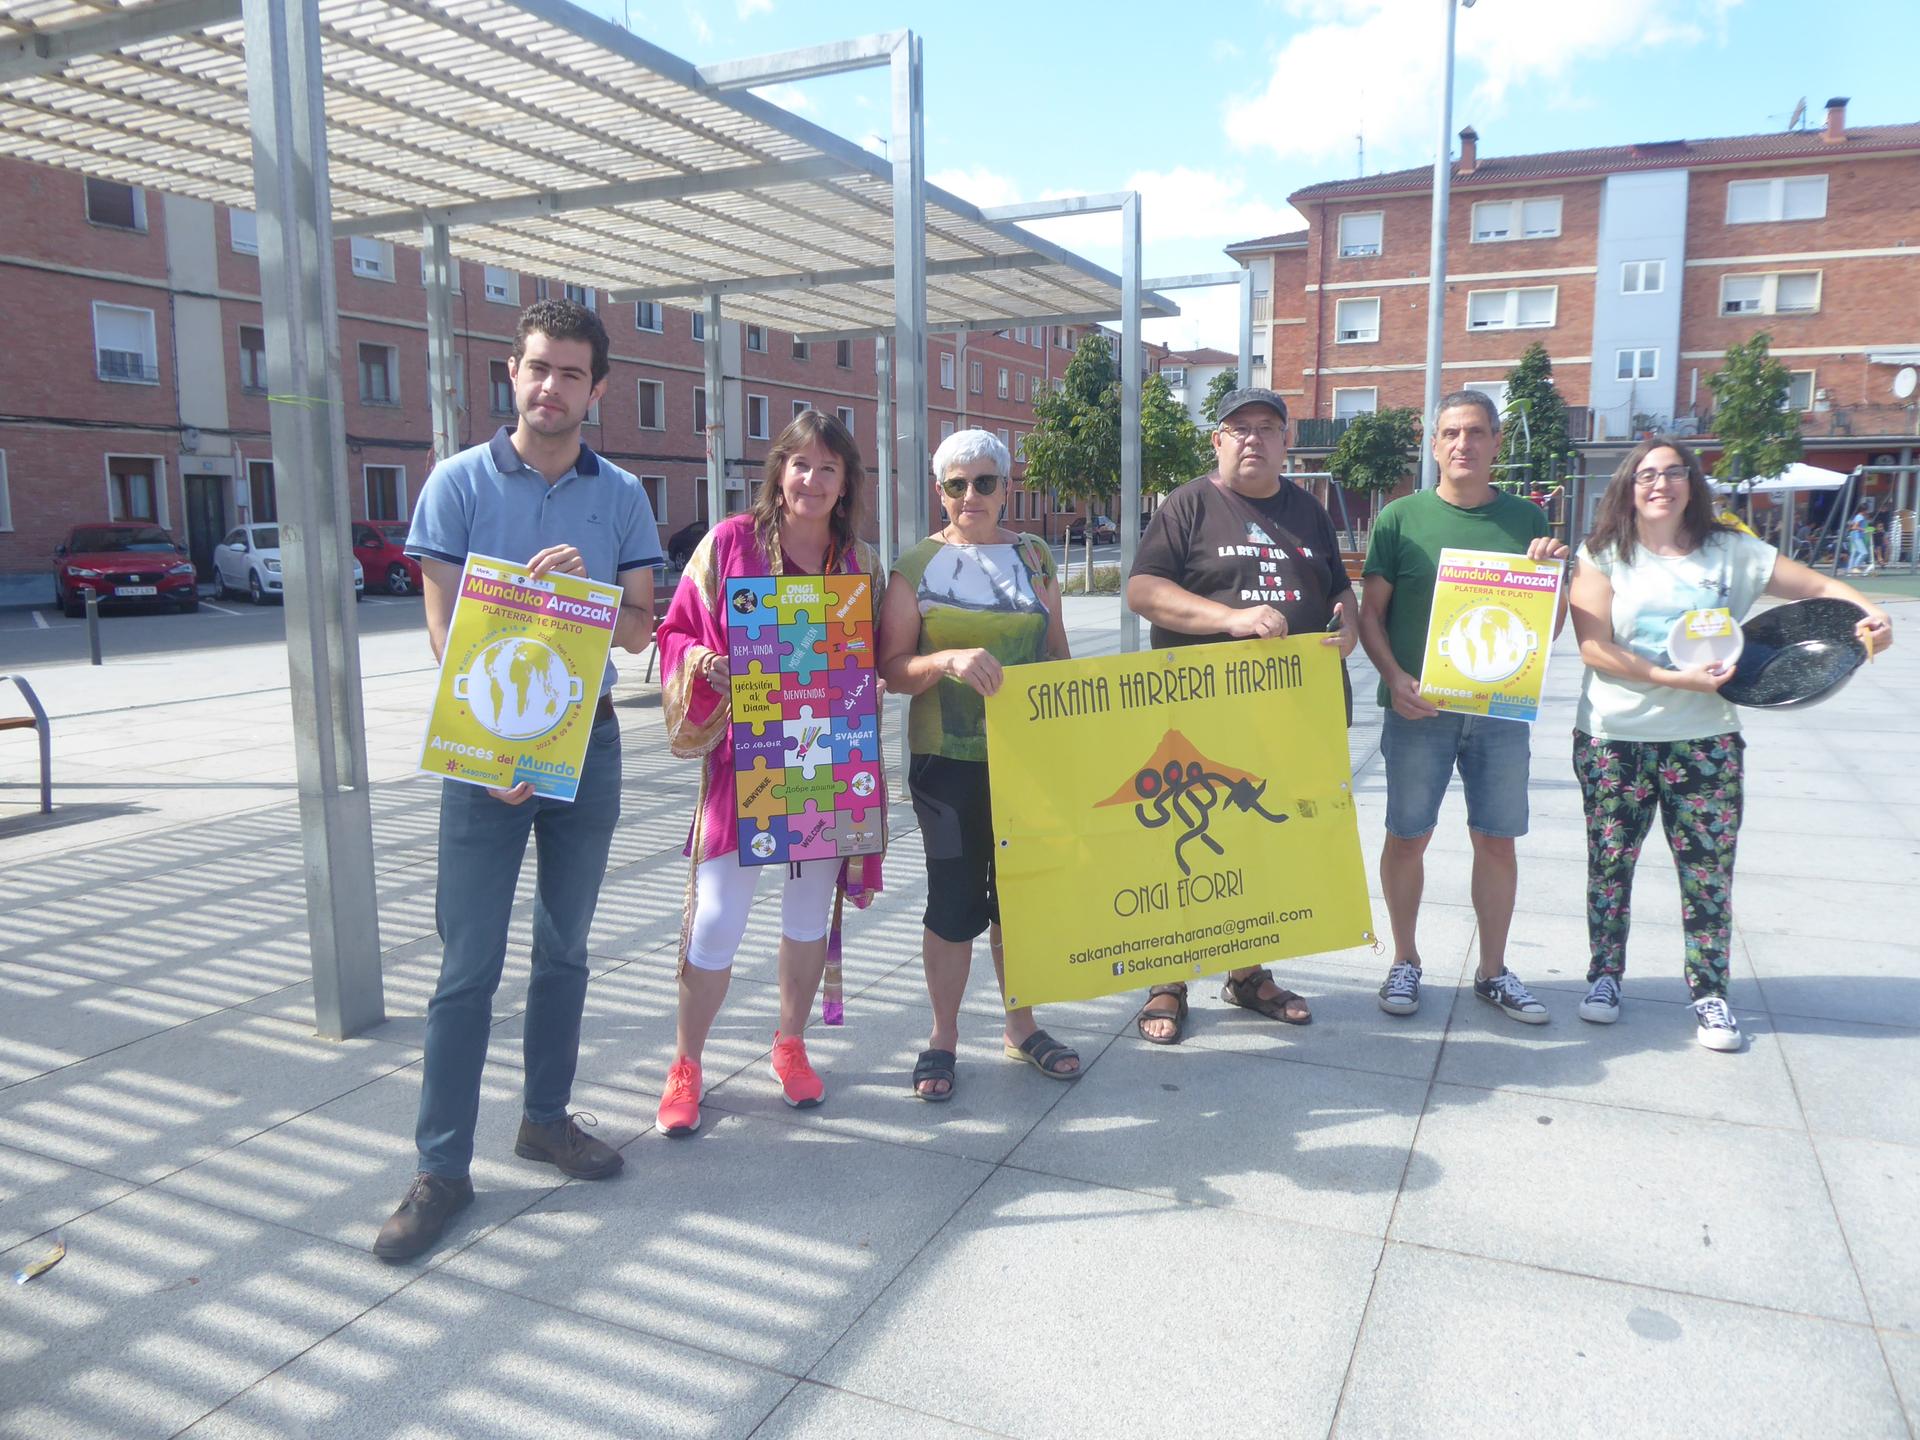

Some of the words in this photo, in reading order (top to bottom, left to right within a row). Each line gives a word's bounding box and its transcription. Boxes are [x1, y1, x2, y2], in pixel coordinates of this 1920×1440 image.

[1218, 546, 1235, 557] LA
[1260, 562, 1277, 573] DE
[1441, 566, 1500, 582] Munduko
[1503, 572, 1555, 588] Arrozak
[466, 577, 544, 607] Munduko
[546, 595, 612, 622] Arrozak
[1454, 585, 1493, 595] PLATERRA
[1508, 591, 1533, 599] PLATO
[482, 605, 533, 623] PLATERRA
[550, 620, 583, 634] PLATO
[750, 691, 760, 701] ak
[784, 688, 826, 700] BIENVENIDAS
[1027, 676, 1111, 721] SAKANA
[1119, 663, 1216, 709] HARRERA
[1225, 654, 1303, 695] HARANA
[1424, 683, 1473, 698] Arroces
[1475, 692, 1488, 700] del
[1491, 691, 1537, 706] Mundo
[743, 704, 770, 713] Diaam
[835, 730, 874, 741] SVAAGAT
[431, 735, 494, 761] Arroces
[497, 753, 514, 765] del
[517, 753, 575, 776] Mundo
[743, 777, 772, 808] BIENVENUE
[801, 819, 827, 848] WELCOME
[1114, 882, 1169, 917] ONGI
[1177, 868, 1244, 908] ETORRI
[1069, 907, 1313, 965] sakanaharreraharana@gmail.com
[1128, 933, 1280, 973] SakanaHarreraHarana
